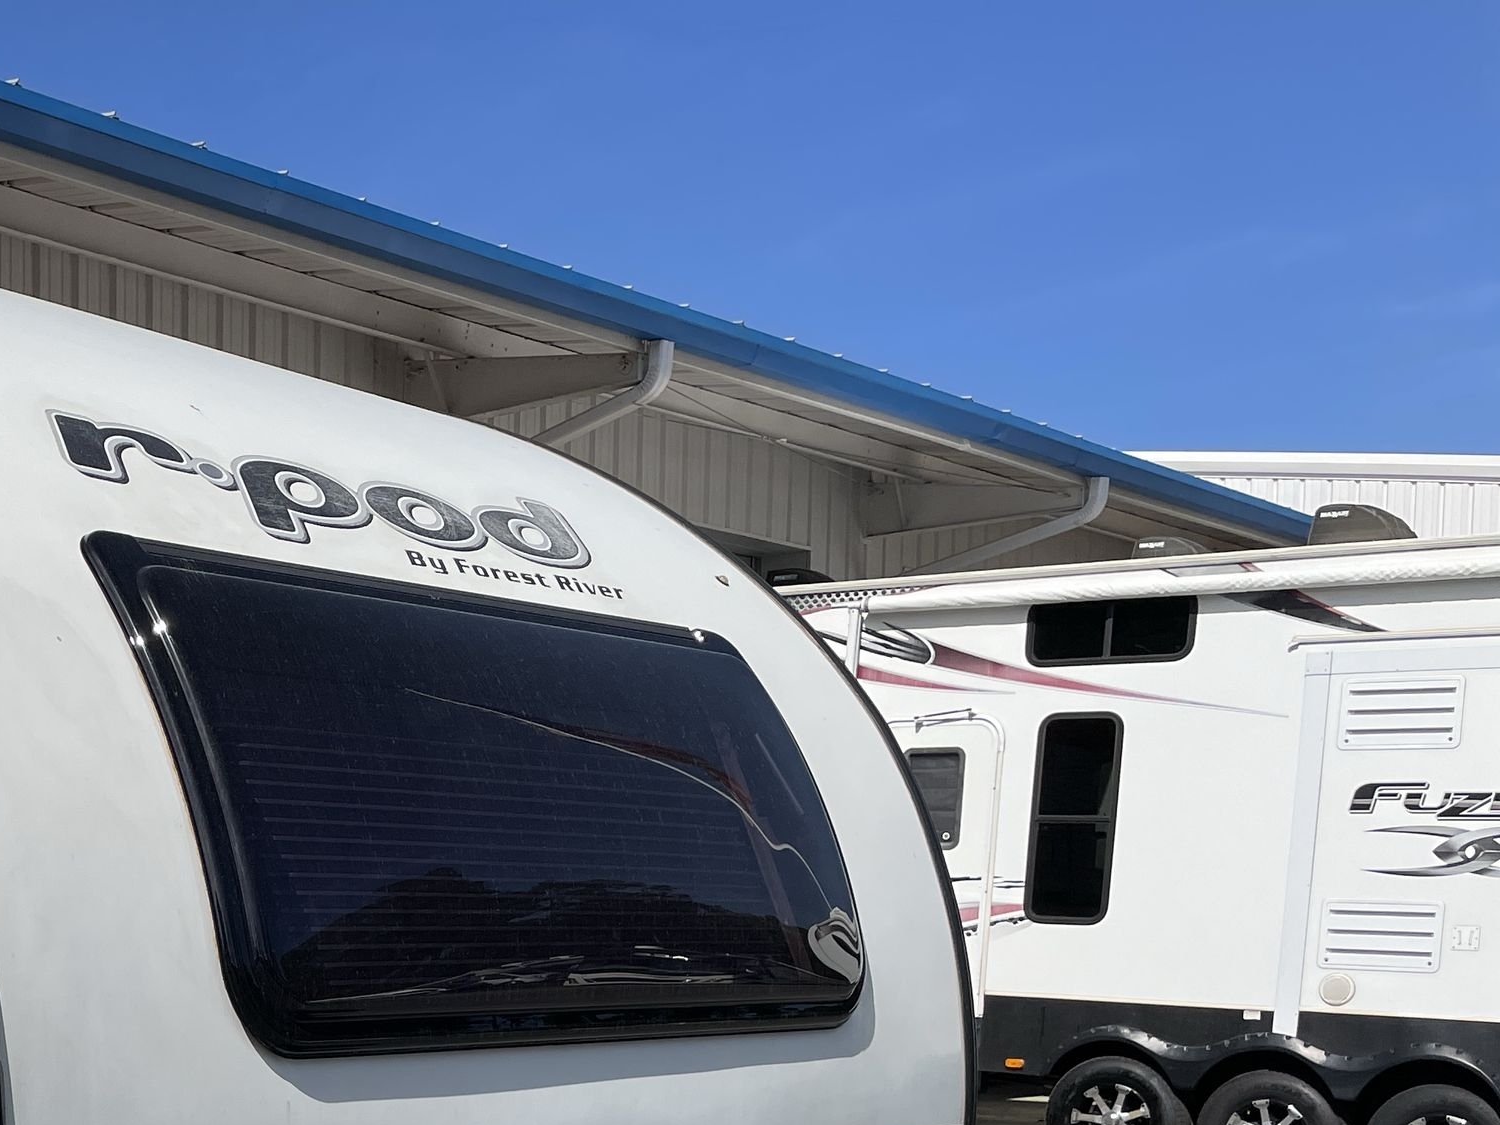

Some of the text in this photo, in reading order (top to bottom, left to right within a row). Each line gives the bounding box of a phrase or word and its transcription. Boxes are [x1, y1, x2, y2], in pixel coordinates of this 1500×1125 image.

[405, 549, 624, 600] By Forest River
